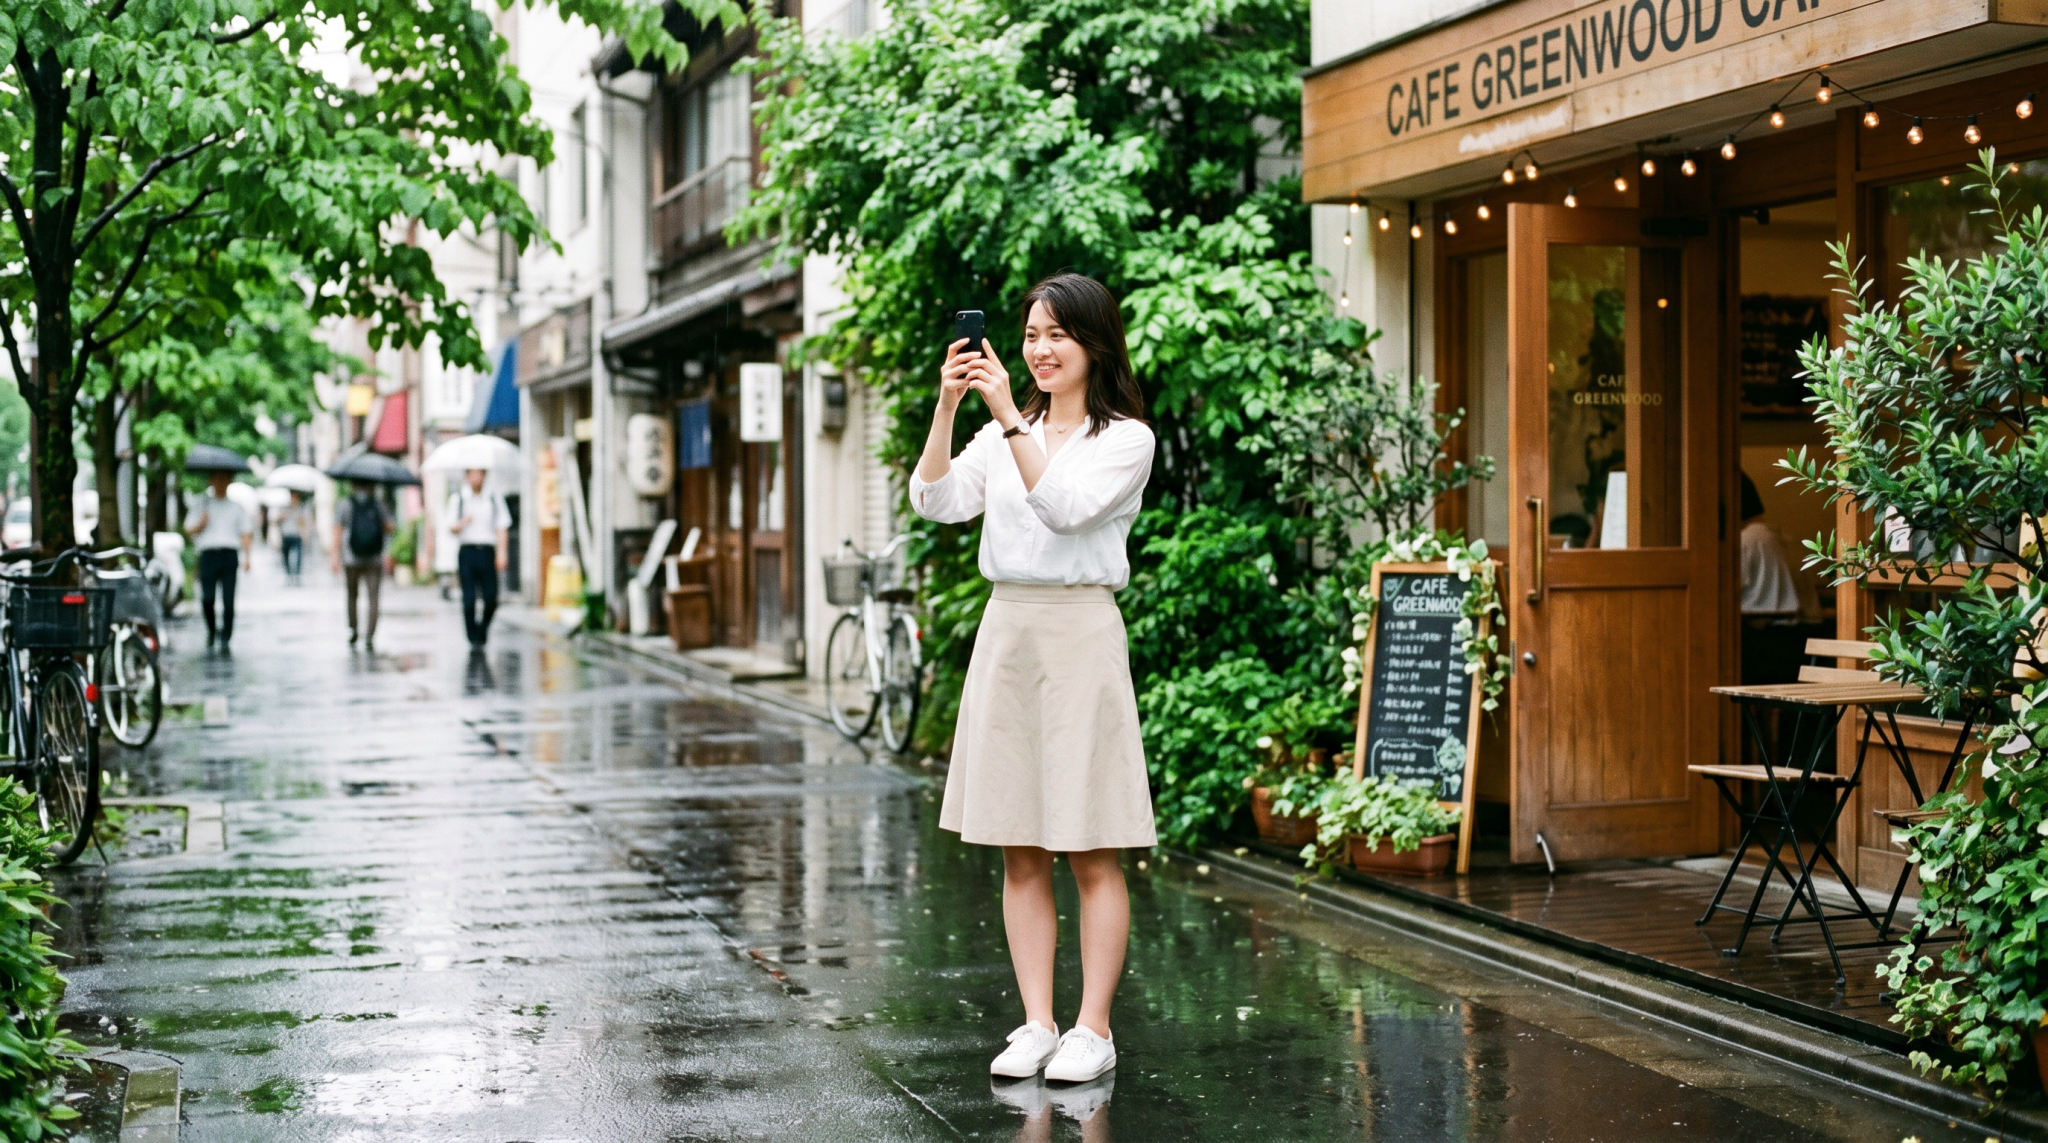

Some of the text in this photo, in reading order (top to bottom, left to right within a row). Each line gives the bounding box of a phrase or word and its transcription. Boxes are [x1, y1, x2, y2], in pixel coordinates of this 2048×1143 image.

[1387, 0, 1722, 136] CAFE GREENWOOD
[1597, 374, 1626, 387] CAF
[1410, 578, 1449, 595] CAFE
